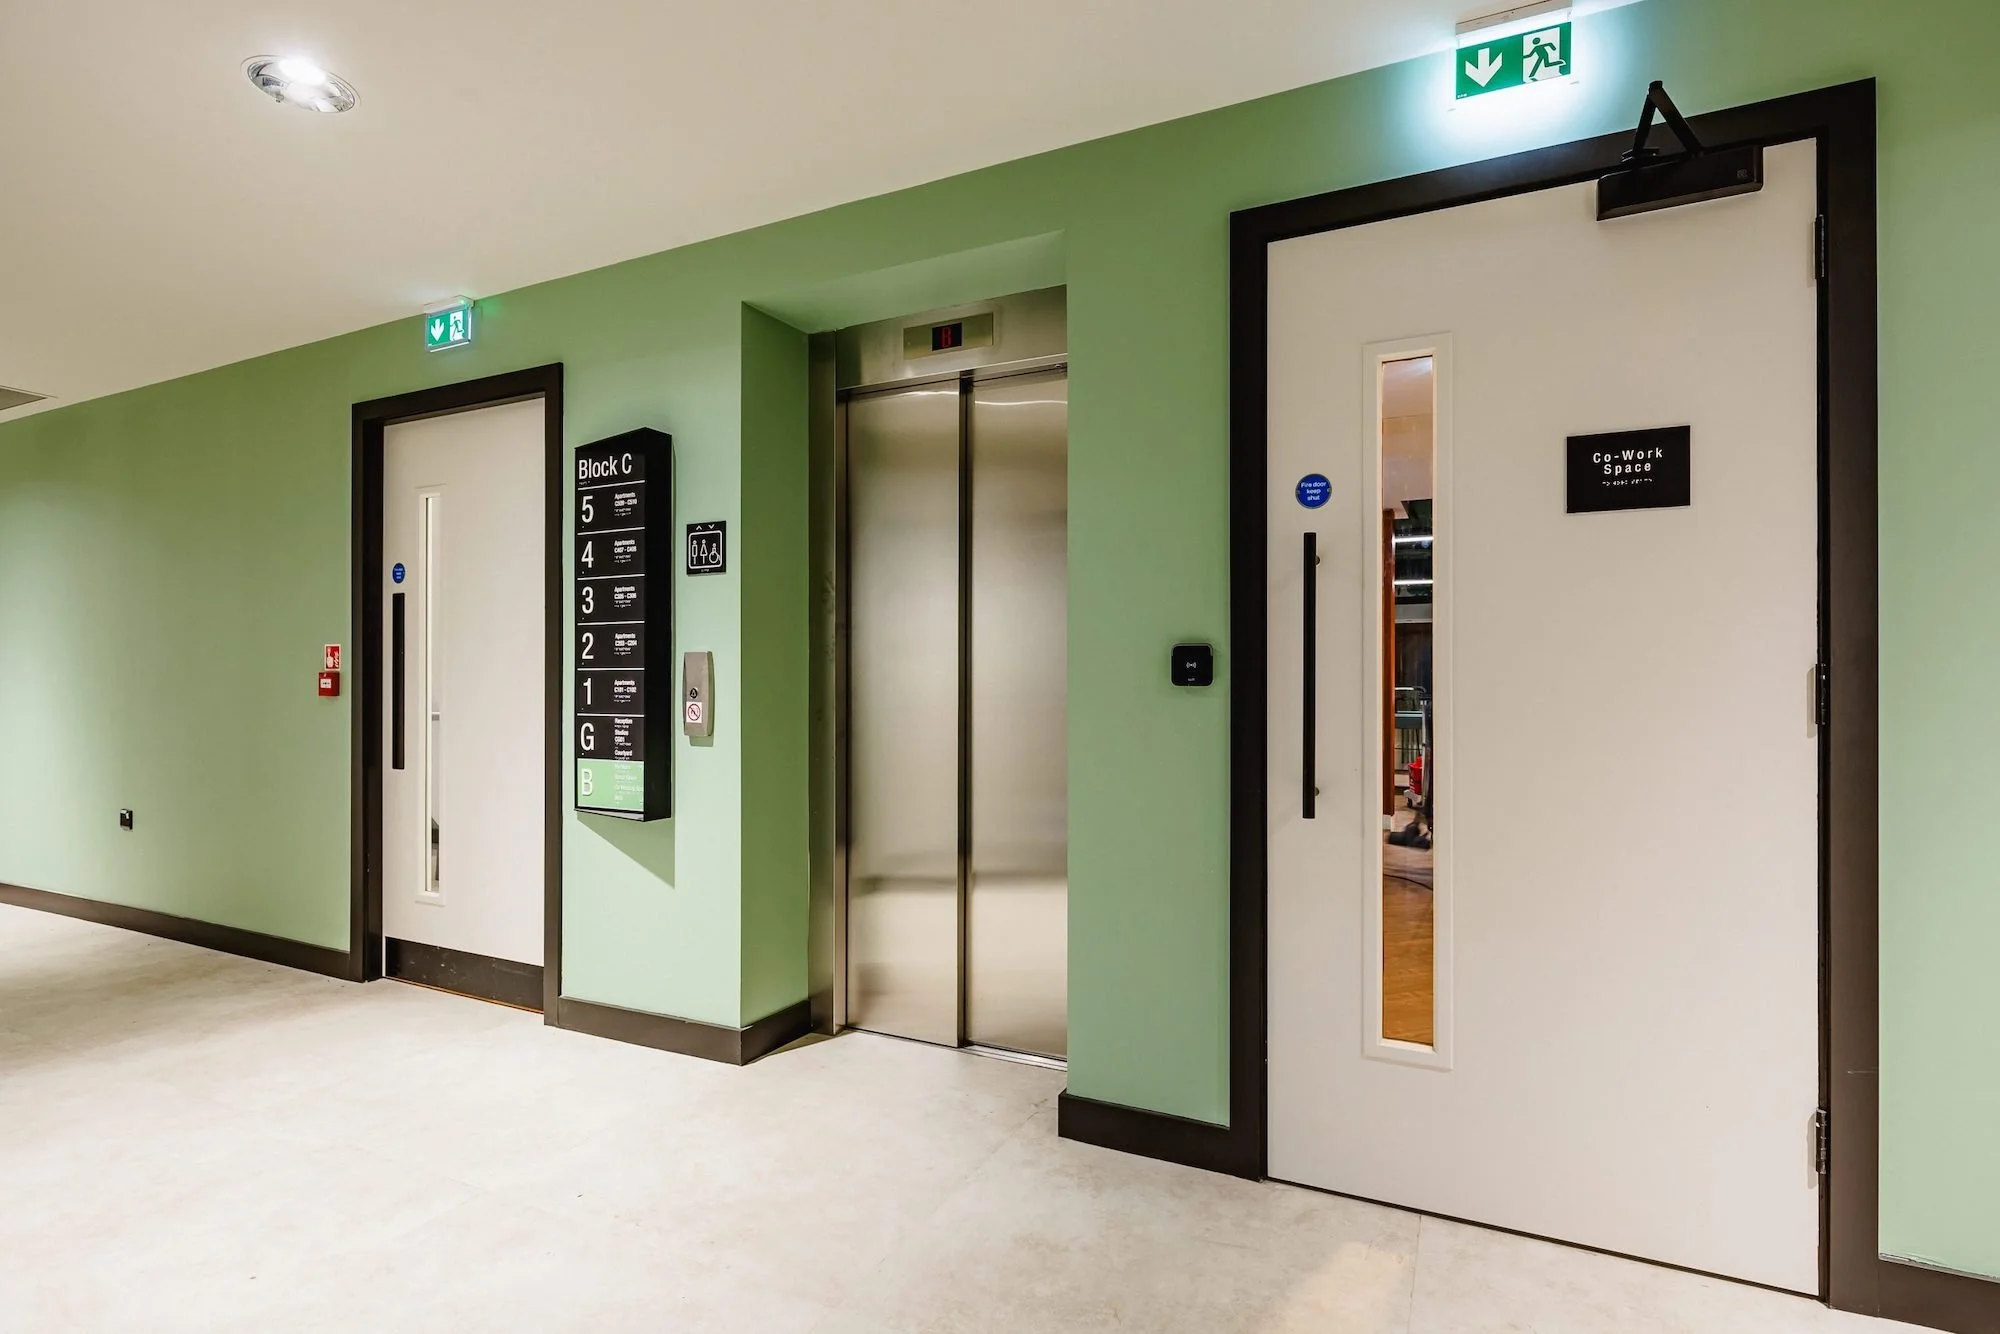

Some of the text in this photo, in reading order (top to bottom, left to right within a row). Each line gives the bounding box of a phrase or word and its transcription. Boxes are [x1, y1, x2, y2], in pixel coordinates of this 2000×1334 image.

[579, 453, 632, 480] Block C
[1593, 447, 1663, 463] Co-Work
[1603, 462, 1651, 476] Space
[581, 495, 594, 523] 5
[614, 492, 636, 500] Apartments
[581, 541, 594, 568] 4
[582, 586, 594, 614] 3
[582, 632, 594, 659] 2
[583, 678, 592, 705] 1
[580, 722, 594, 751] G
[581, 768, 593, 797] B
